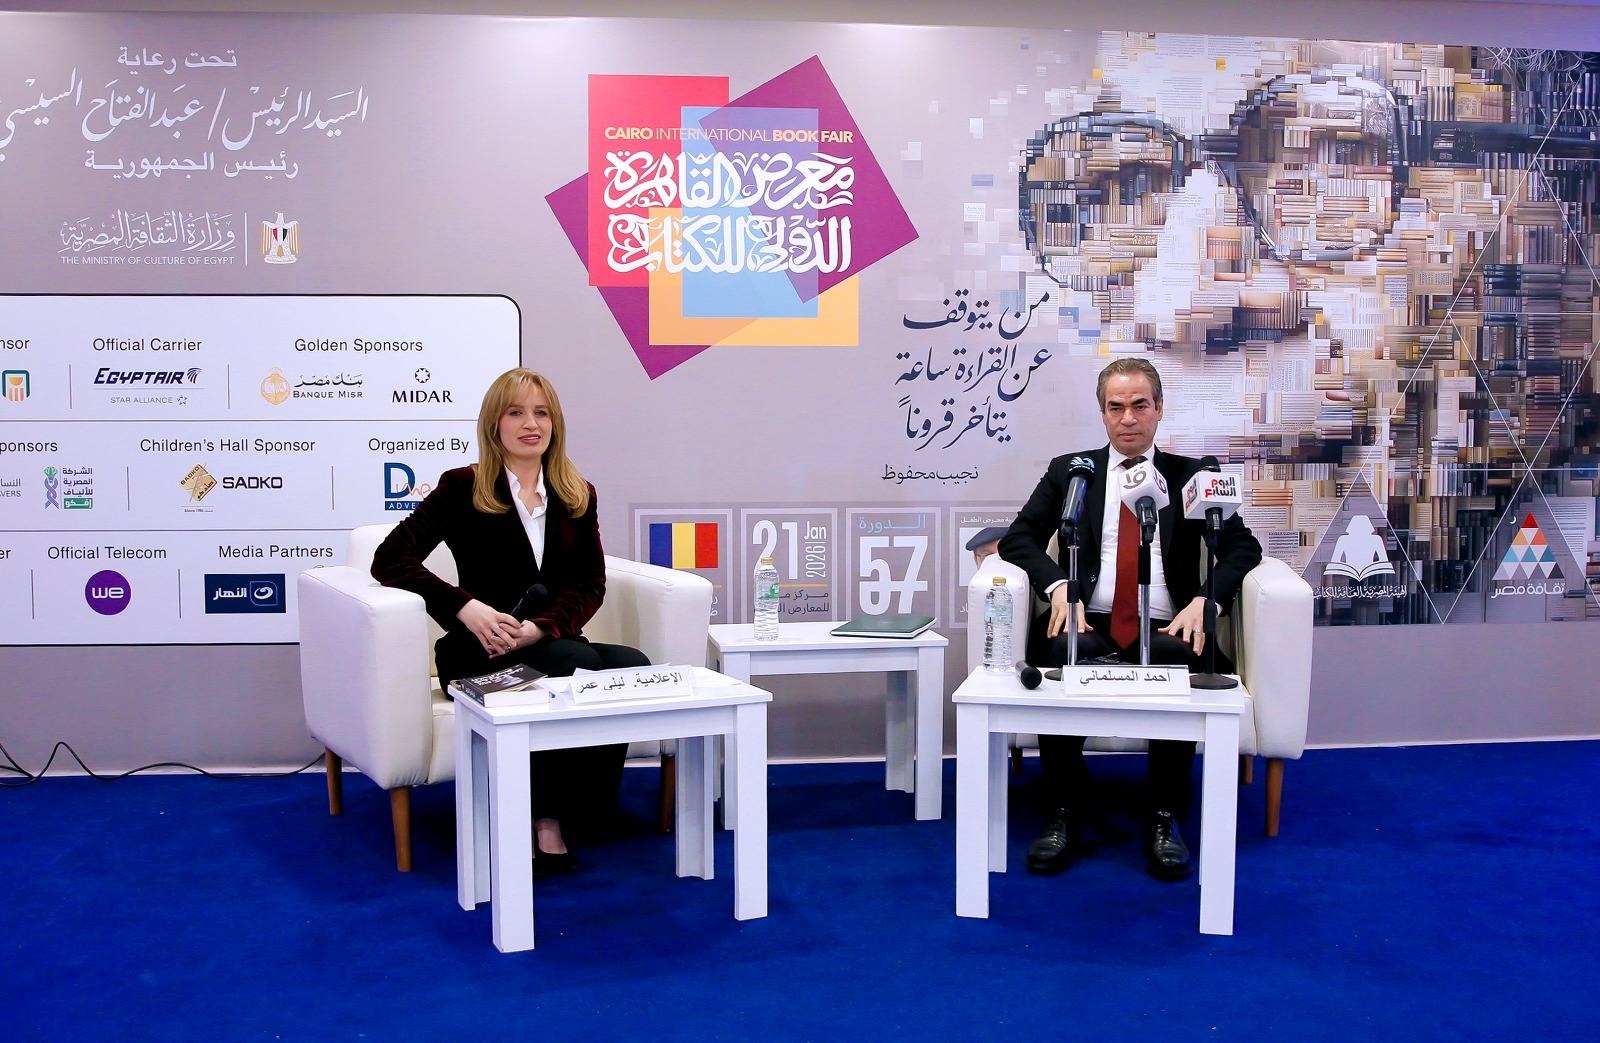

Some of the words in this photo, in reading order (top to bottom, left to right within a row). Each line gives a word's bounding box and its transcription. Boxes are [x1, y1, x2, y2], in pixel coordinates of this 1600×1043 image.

[117, 46, 177, 74] رعاية
[184, 49, 238, 68] تحت
[604, 127, 654, 141] CAIRO
[655, 128, 772, 142] INTERNATIONAL
[773, 129, 819, 143] BOOK
[821, 130, 854, 143] FAIR
[84, 151, 215, 180] الجمهورية
[224, 151, 299, 180] رئيس
[61, 257, 80, 265] THE
[82, 257, 126, 265] MINISTRY
[128, 257, 142, 265] OF
[144, 257, 186, 265] CULTURE
[187, 257, 202, 265] OF
[204, 257, 235, 265] EGYPT
[903, 288, 993, 331] يتوقف
[998, 291, 1050, 340] من
[92, 338, 145, 351] Official
[150, 338, 202, 351] Carrier
[294, 338, 348, 352] Golden
[353, 338, 423, 354] Sponsors
[895, 346, 952, 386] ساعة
[953, 343, 1018, 393] القراءة
[997, 348, 1053, 402] عن
[110, 396, 131, 404] STAR
[133, 396, 174, 404] ALLIANCE
[392, 390, 453, 403] MIDAR
[942, 396, 1012, 449] يتأخر
[220, 438, 248, 452] Hall
[254, 438, 316, 454] Sponsor
[368, 438, 445, 454] Organized
[450, 438, 470, 454] By
[62, 467, 93, 477] الشركة
[881, 463, 936, 485] محفوظ
[936, 466, 979, 485] نجيب
[63, 478, 93, 487] المصرية
[222, 476, 283, 489] SADKO
[388, 502, 419, 510] ADVE
[803, 521, 827, 540] Jan
[859, 513, 928, 533] الدورة
[47, 546, 99, 559] Official
[104, 546, 167, 559] Telecom
[218, 545, 264, 559] Media
[269, 545, 334, 559] Partners
[805, 545, 826, 578] 2026
[213, 587, 247, 601] النهار
[793, 589, 829, 601] مركز
[1490, 585, 1526, 598] مصر
[1526, 582, 1566, 595] ثقافة
[788, 602, 830, 615] للمعارض
[603, 676, 626, 691] ليلى
[1079, 669, 1139, 686] المسلماني
[579, 681, 598, 694] عمر
